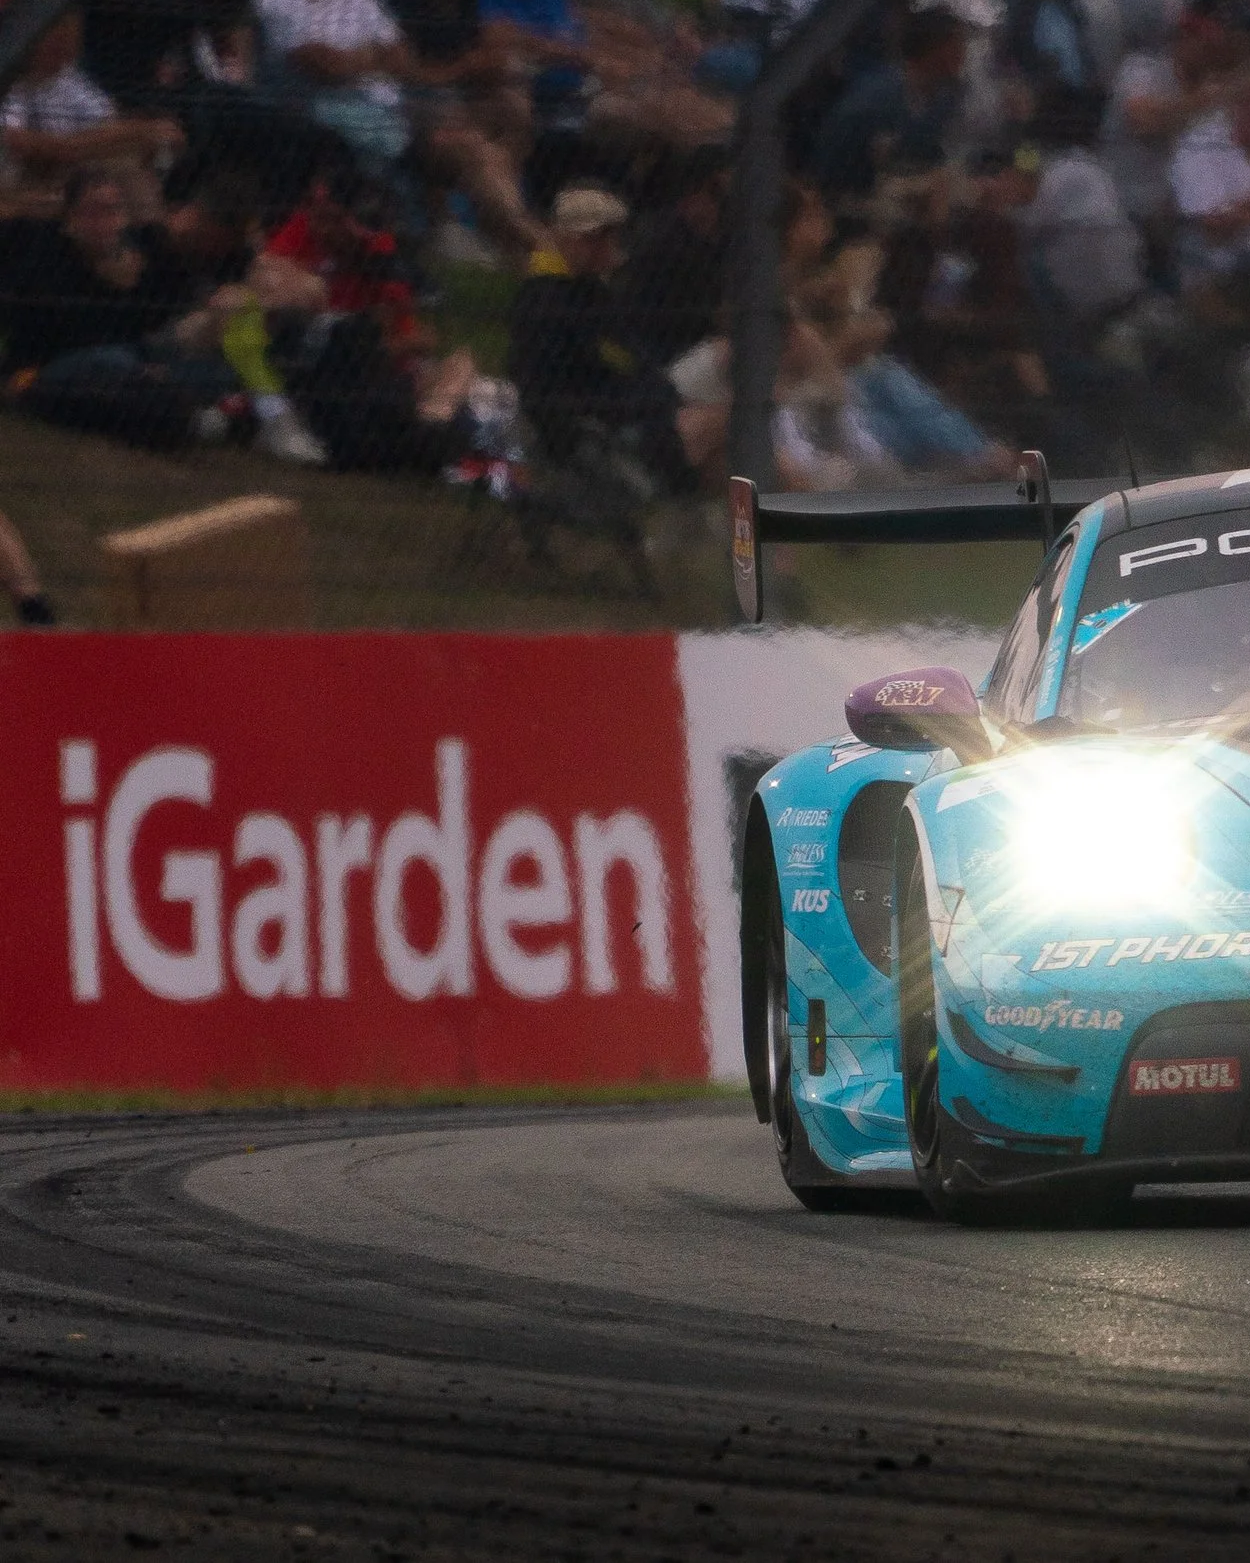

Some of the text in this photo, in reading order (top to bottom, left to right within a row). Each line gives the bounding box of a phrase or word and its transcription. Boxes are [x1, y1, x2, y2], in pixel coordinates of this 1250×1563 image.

[60, 738, 673, 1002] iGarden
[792, 889, 830, 913] KUS
[1031, 939, 1116, 973] 1ST
[985, 1000, 1124, 1032] GOODYEAR
[1135, 1063, 1236, 1091] MOTUL
